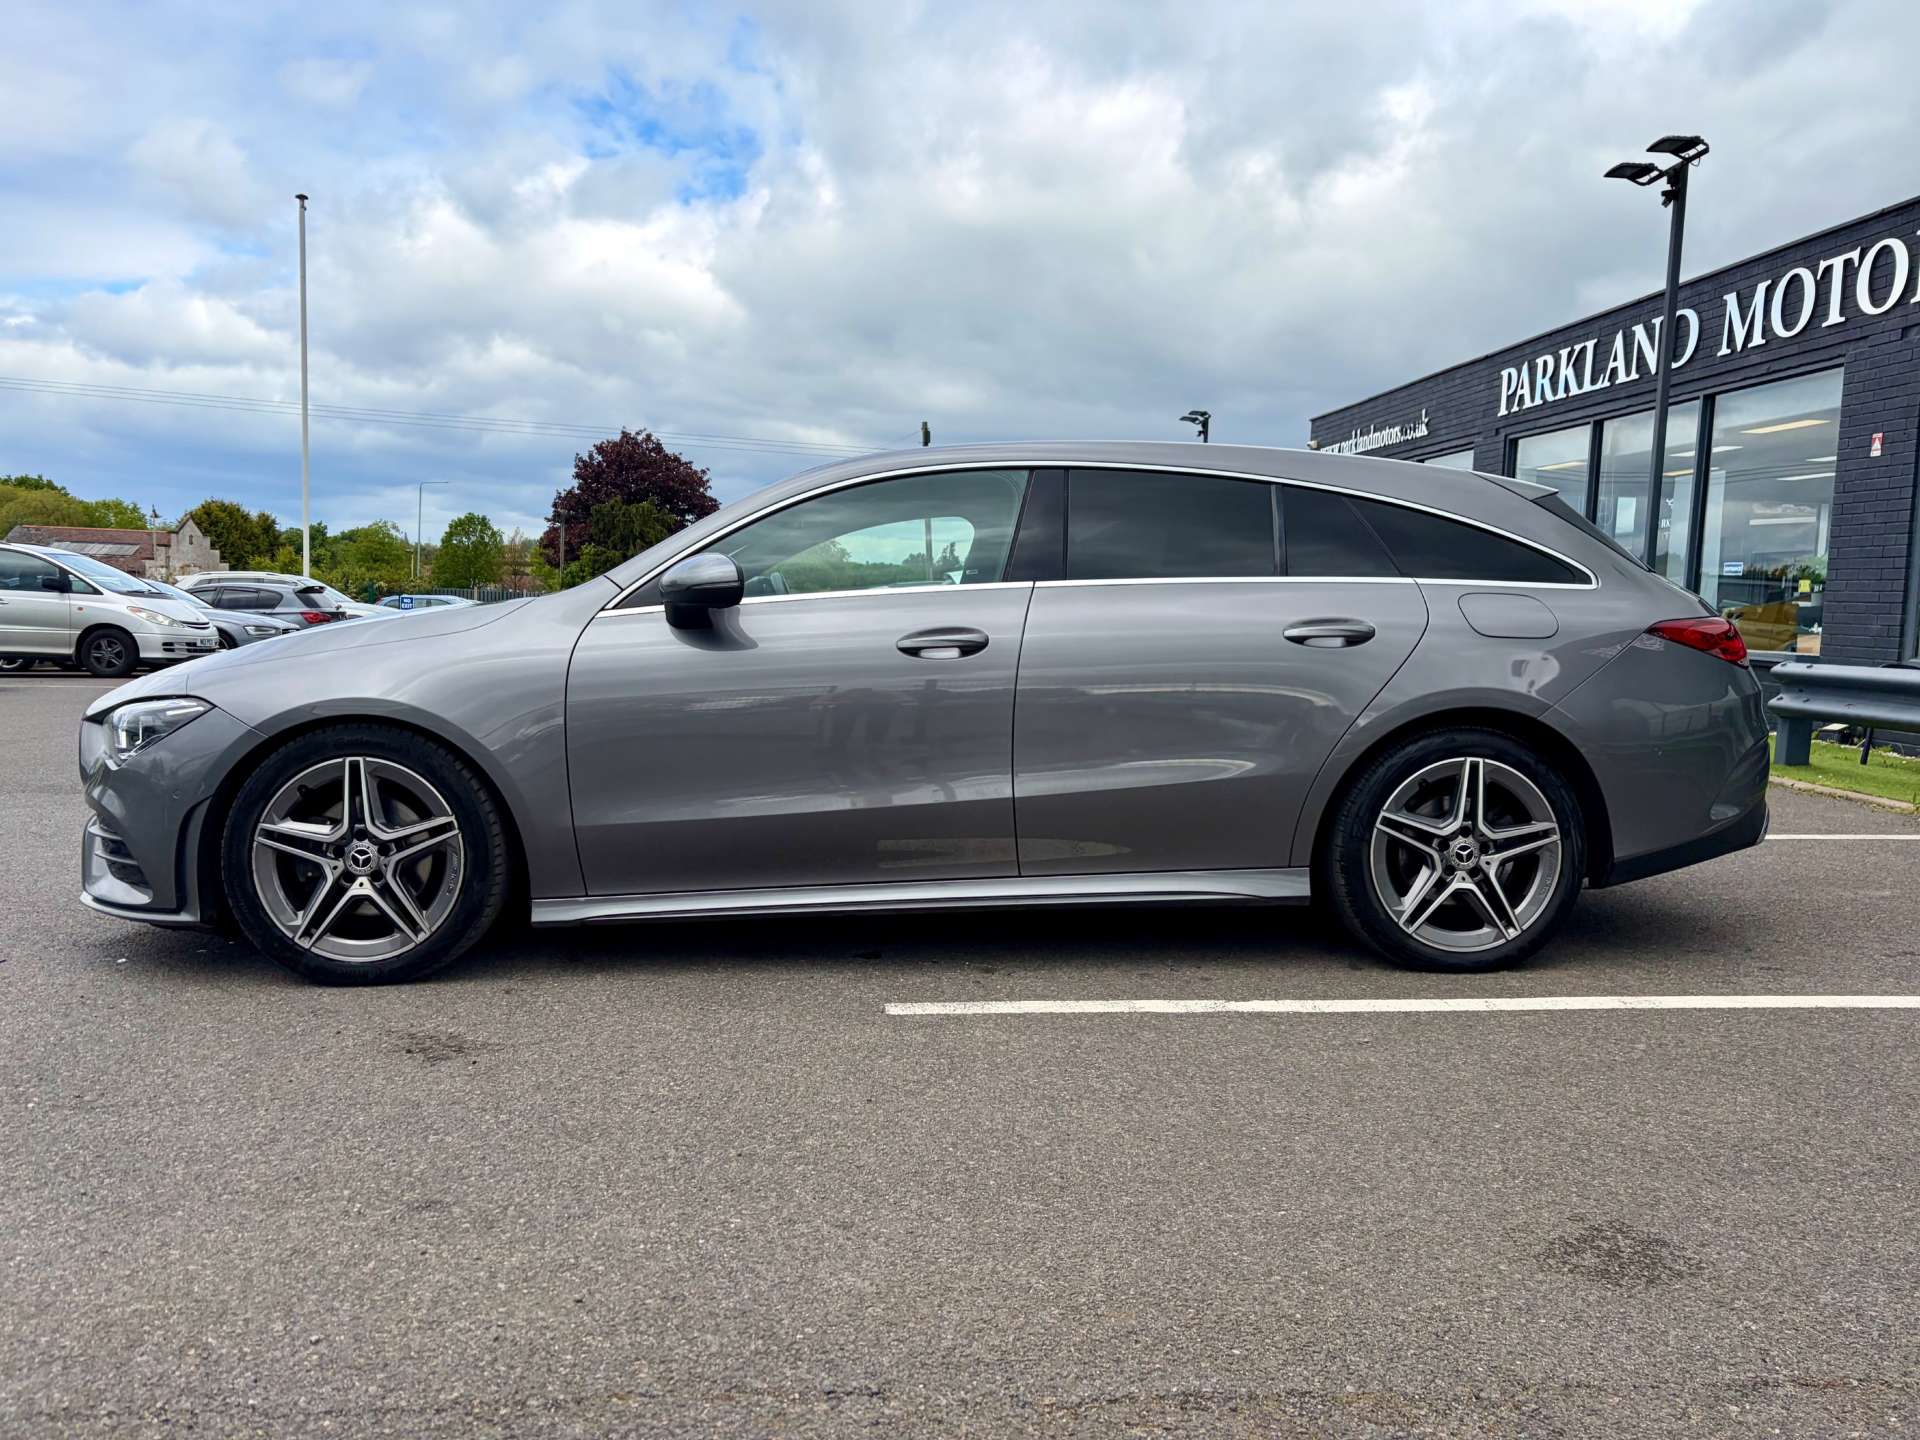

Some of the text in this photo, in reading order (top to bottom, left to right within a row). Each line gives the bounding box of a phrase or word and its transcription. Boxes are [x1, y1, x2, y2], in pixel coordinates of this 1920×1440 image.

[1498, 230, 1920, 417] PARKLAND MOTO
[1320, 408, 1429, 455] wwparklandmotors.co.uk
